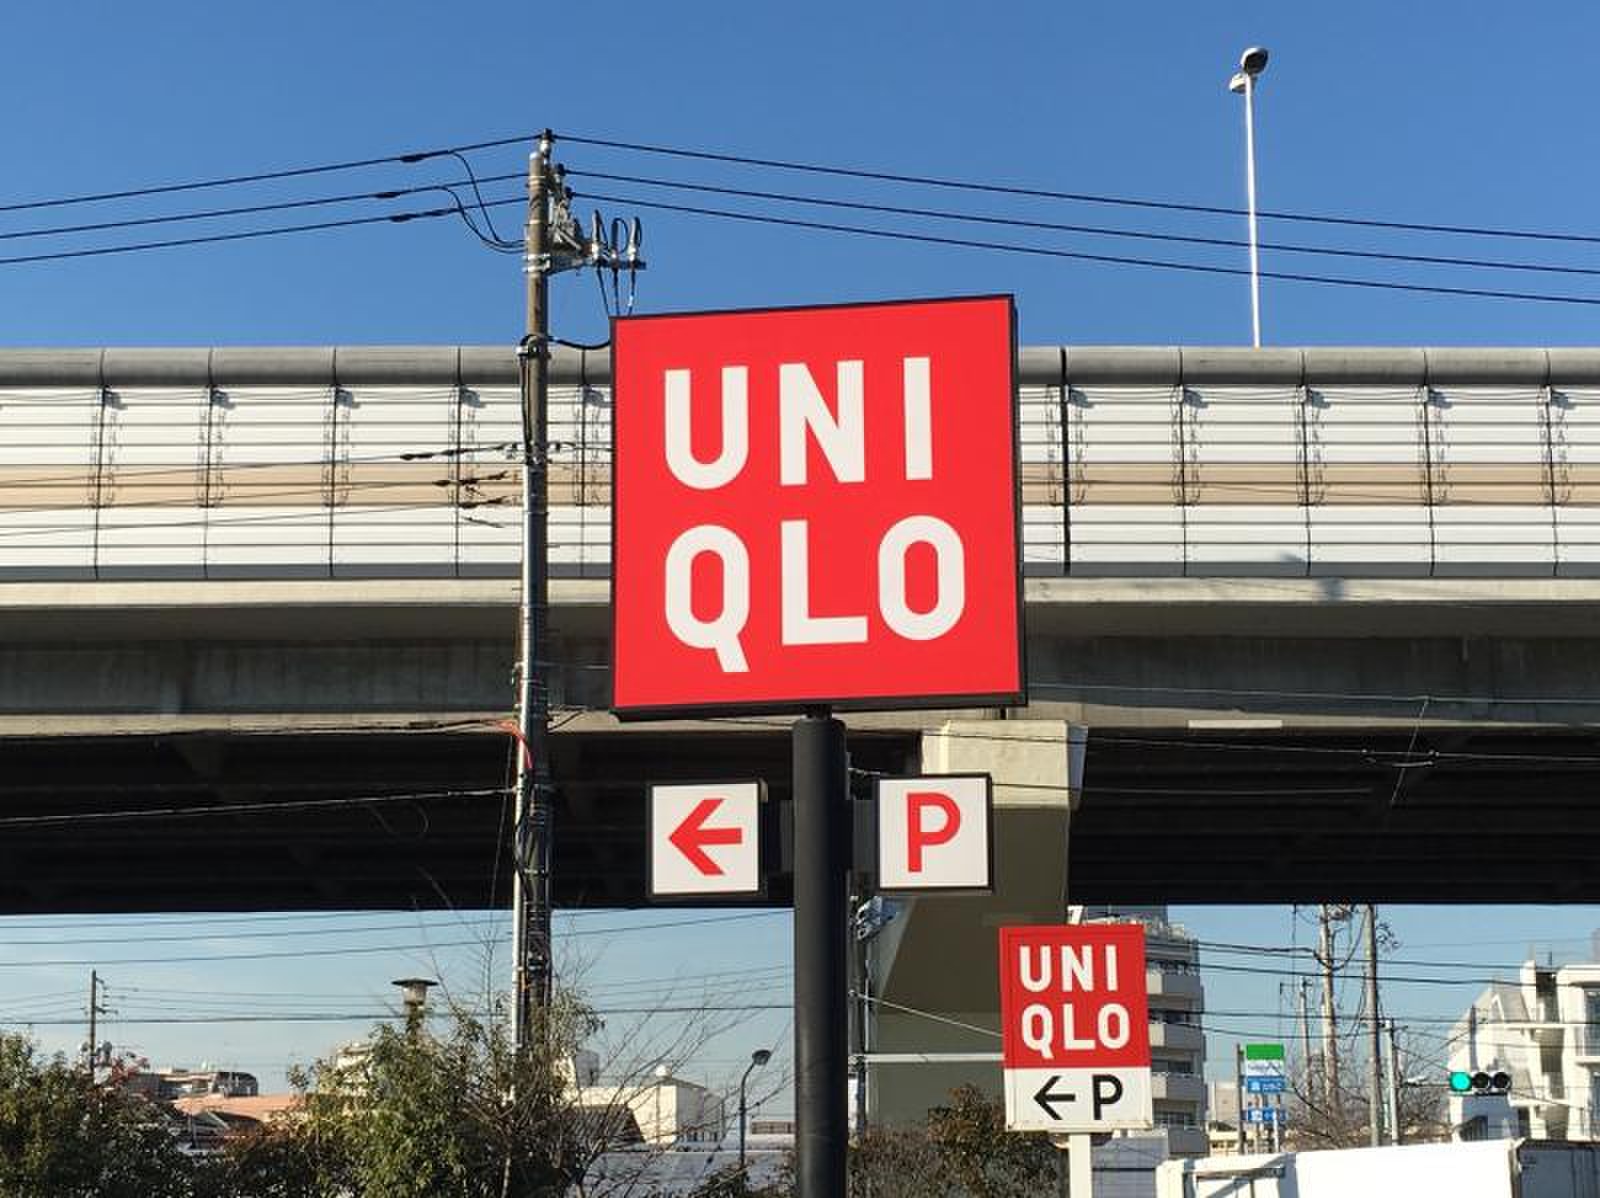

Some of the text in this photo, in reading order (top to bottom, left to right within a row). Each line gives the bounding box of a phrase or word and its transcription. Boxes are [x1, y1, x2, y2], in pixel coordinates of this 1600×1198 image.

[664, 356, 933, 490] UNI
[664, 515, 966, 673] QLO
[906, 792, 961, 873] P
[1019, 944, 1118, 993] UNI
[1021, 1003, 1131, 1060] QLO
[1092, 1074, 1123, 1121] P
